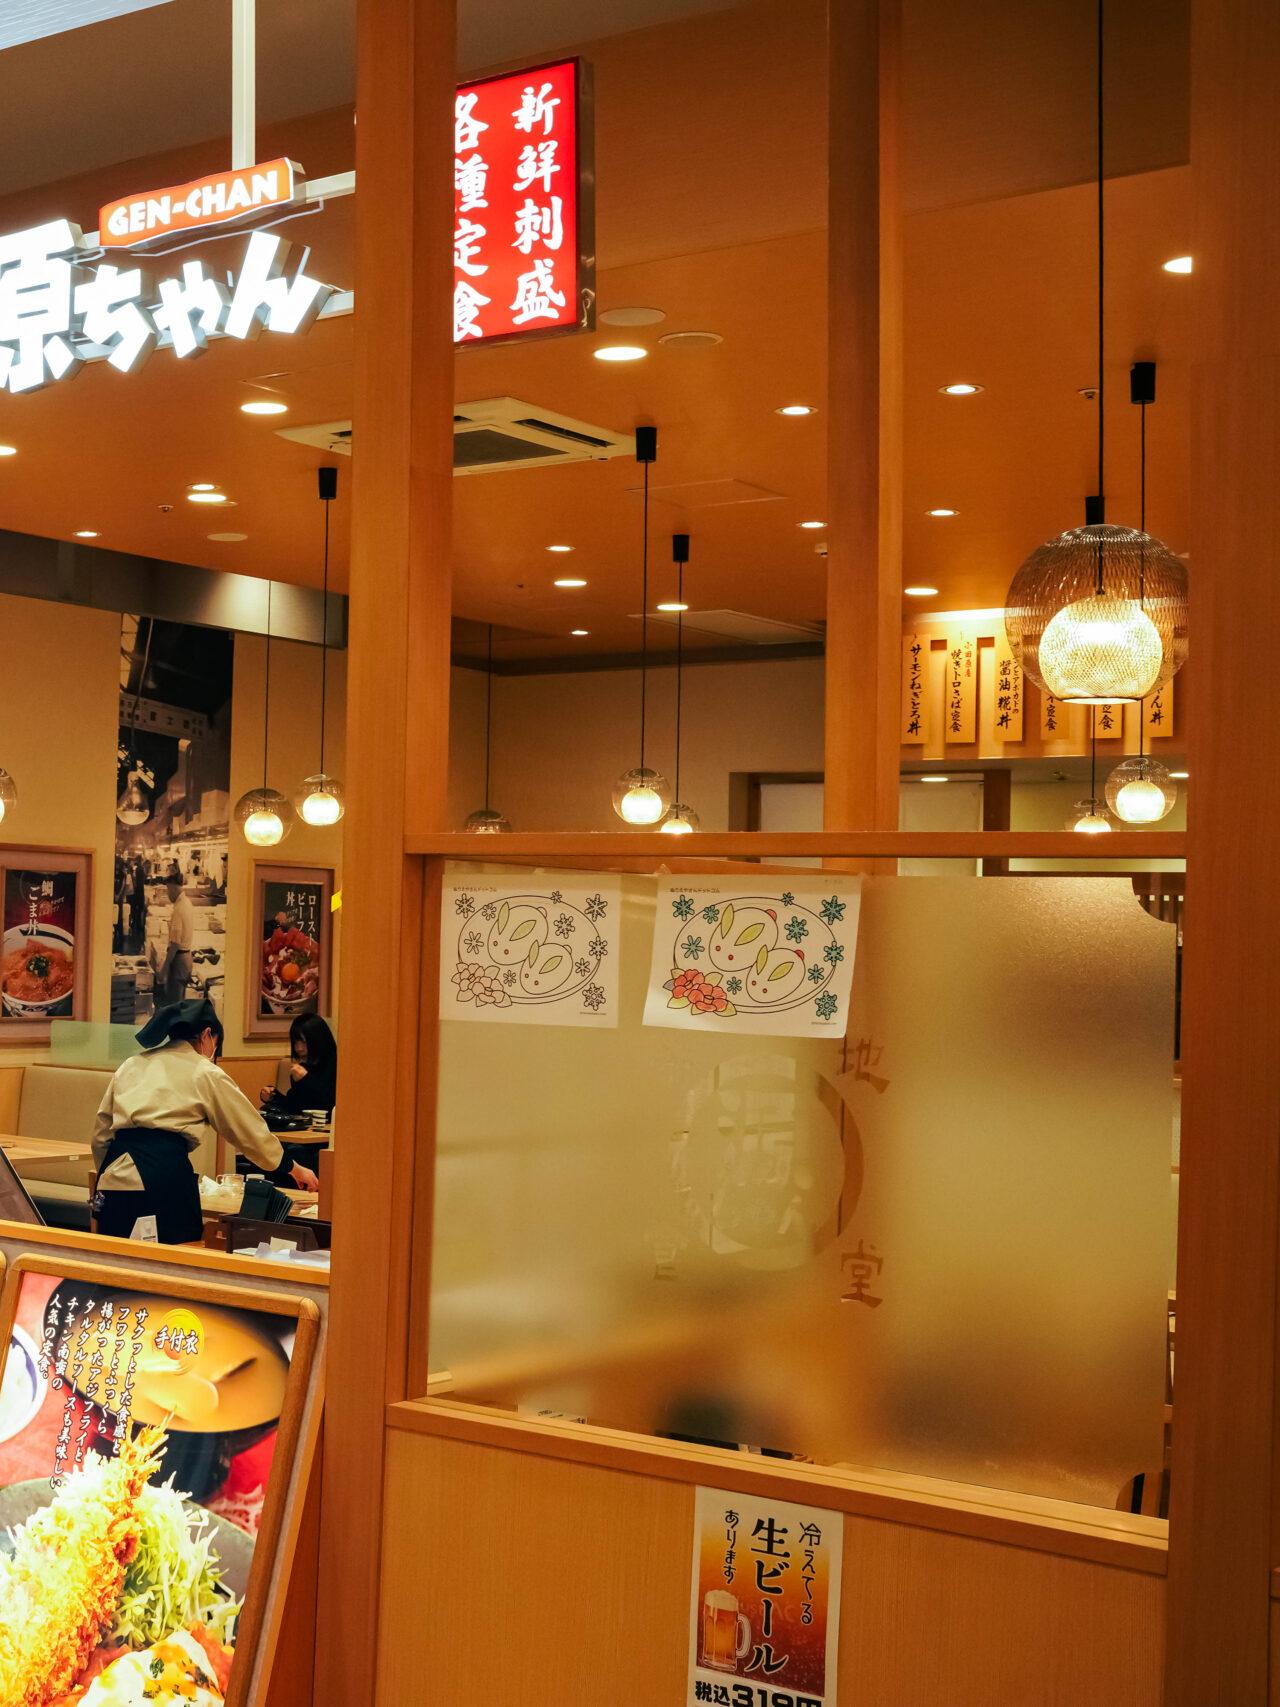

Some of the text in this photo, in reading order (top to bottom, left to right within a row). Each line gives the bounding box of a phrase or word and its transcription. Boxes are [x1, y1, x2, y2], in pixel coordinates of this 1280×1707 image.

[108, 168, 278, 237] GEN-CHAN
[510, 82, 566, 326] 新鮮刺盛
[840, 1239, 883, 1309] 堂
[74, 1301, 113, 1463] 揚がったアジフライと
[97, 1306, 131, 1435] フワッとふっくら
[723, 1509, 740, 1584] あります
[744, 1517, 791, 1675] 生ビール
[799, 1522, 821, 1625] 冷えてる
